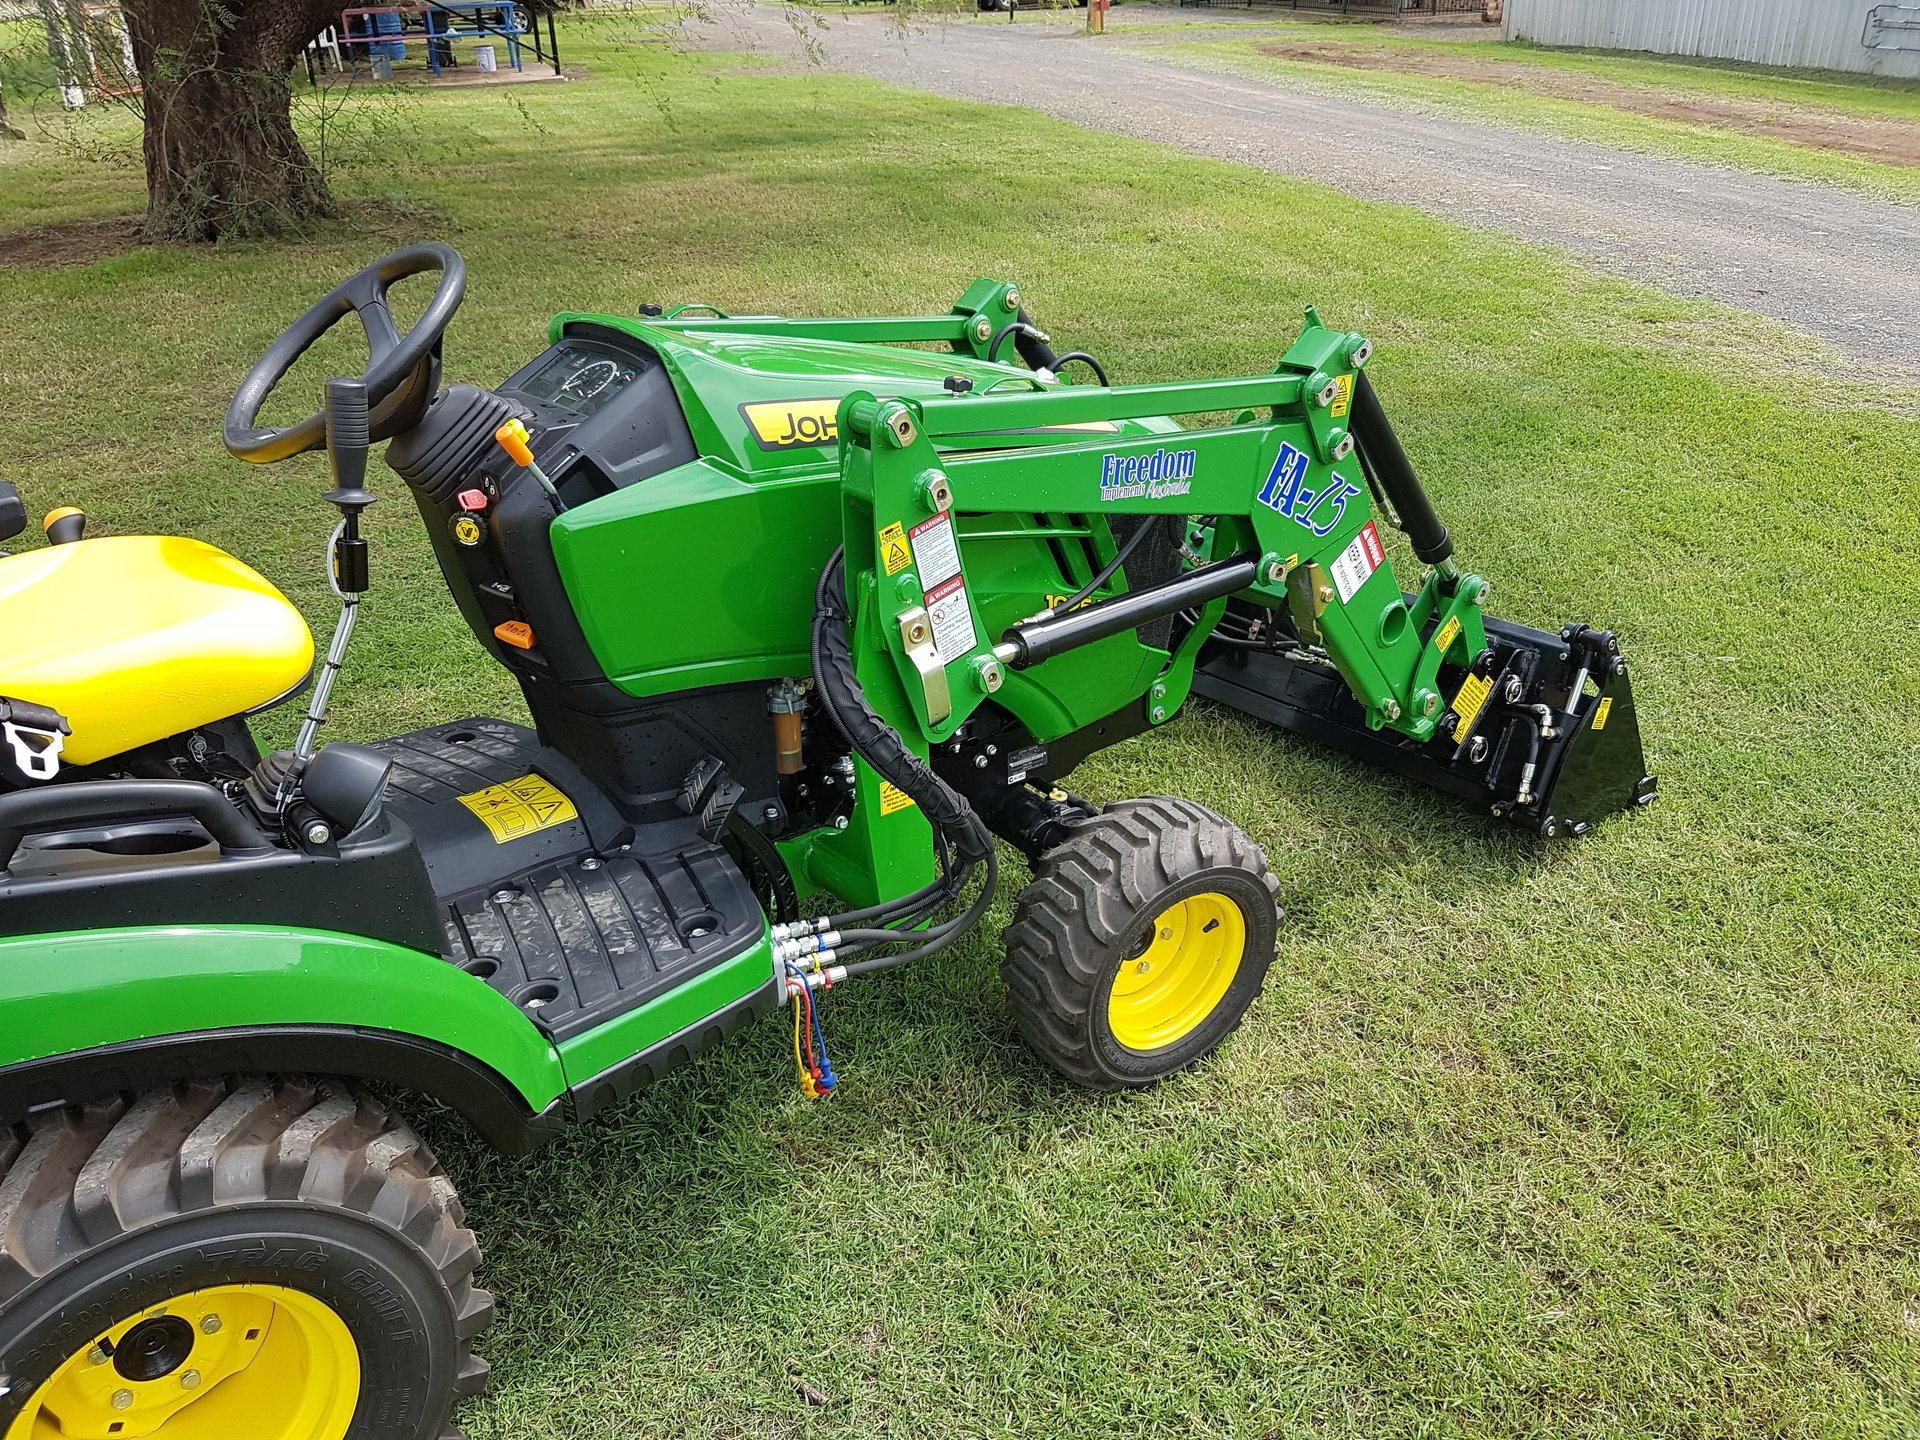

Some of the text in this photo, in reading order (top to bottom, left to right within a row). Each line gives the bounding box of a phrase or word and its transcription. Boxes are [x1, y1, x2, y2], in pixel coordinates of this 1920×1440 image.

[1100, 449, 1195, 488] Freedom
[1101, 483, 1145, 501] Implements
[1145, 476, 1191, 499] Australia
[920, 515, 945, 532] WARNING
[1347, 542, 1367, 584] KEEP AWAY
[934, 581, 961, 599] WARNING
[205, 1247, 418, 1346] TRAC CHIEF
